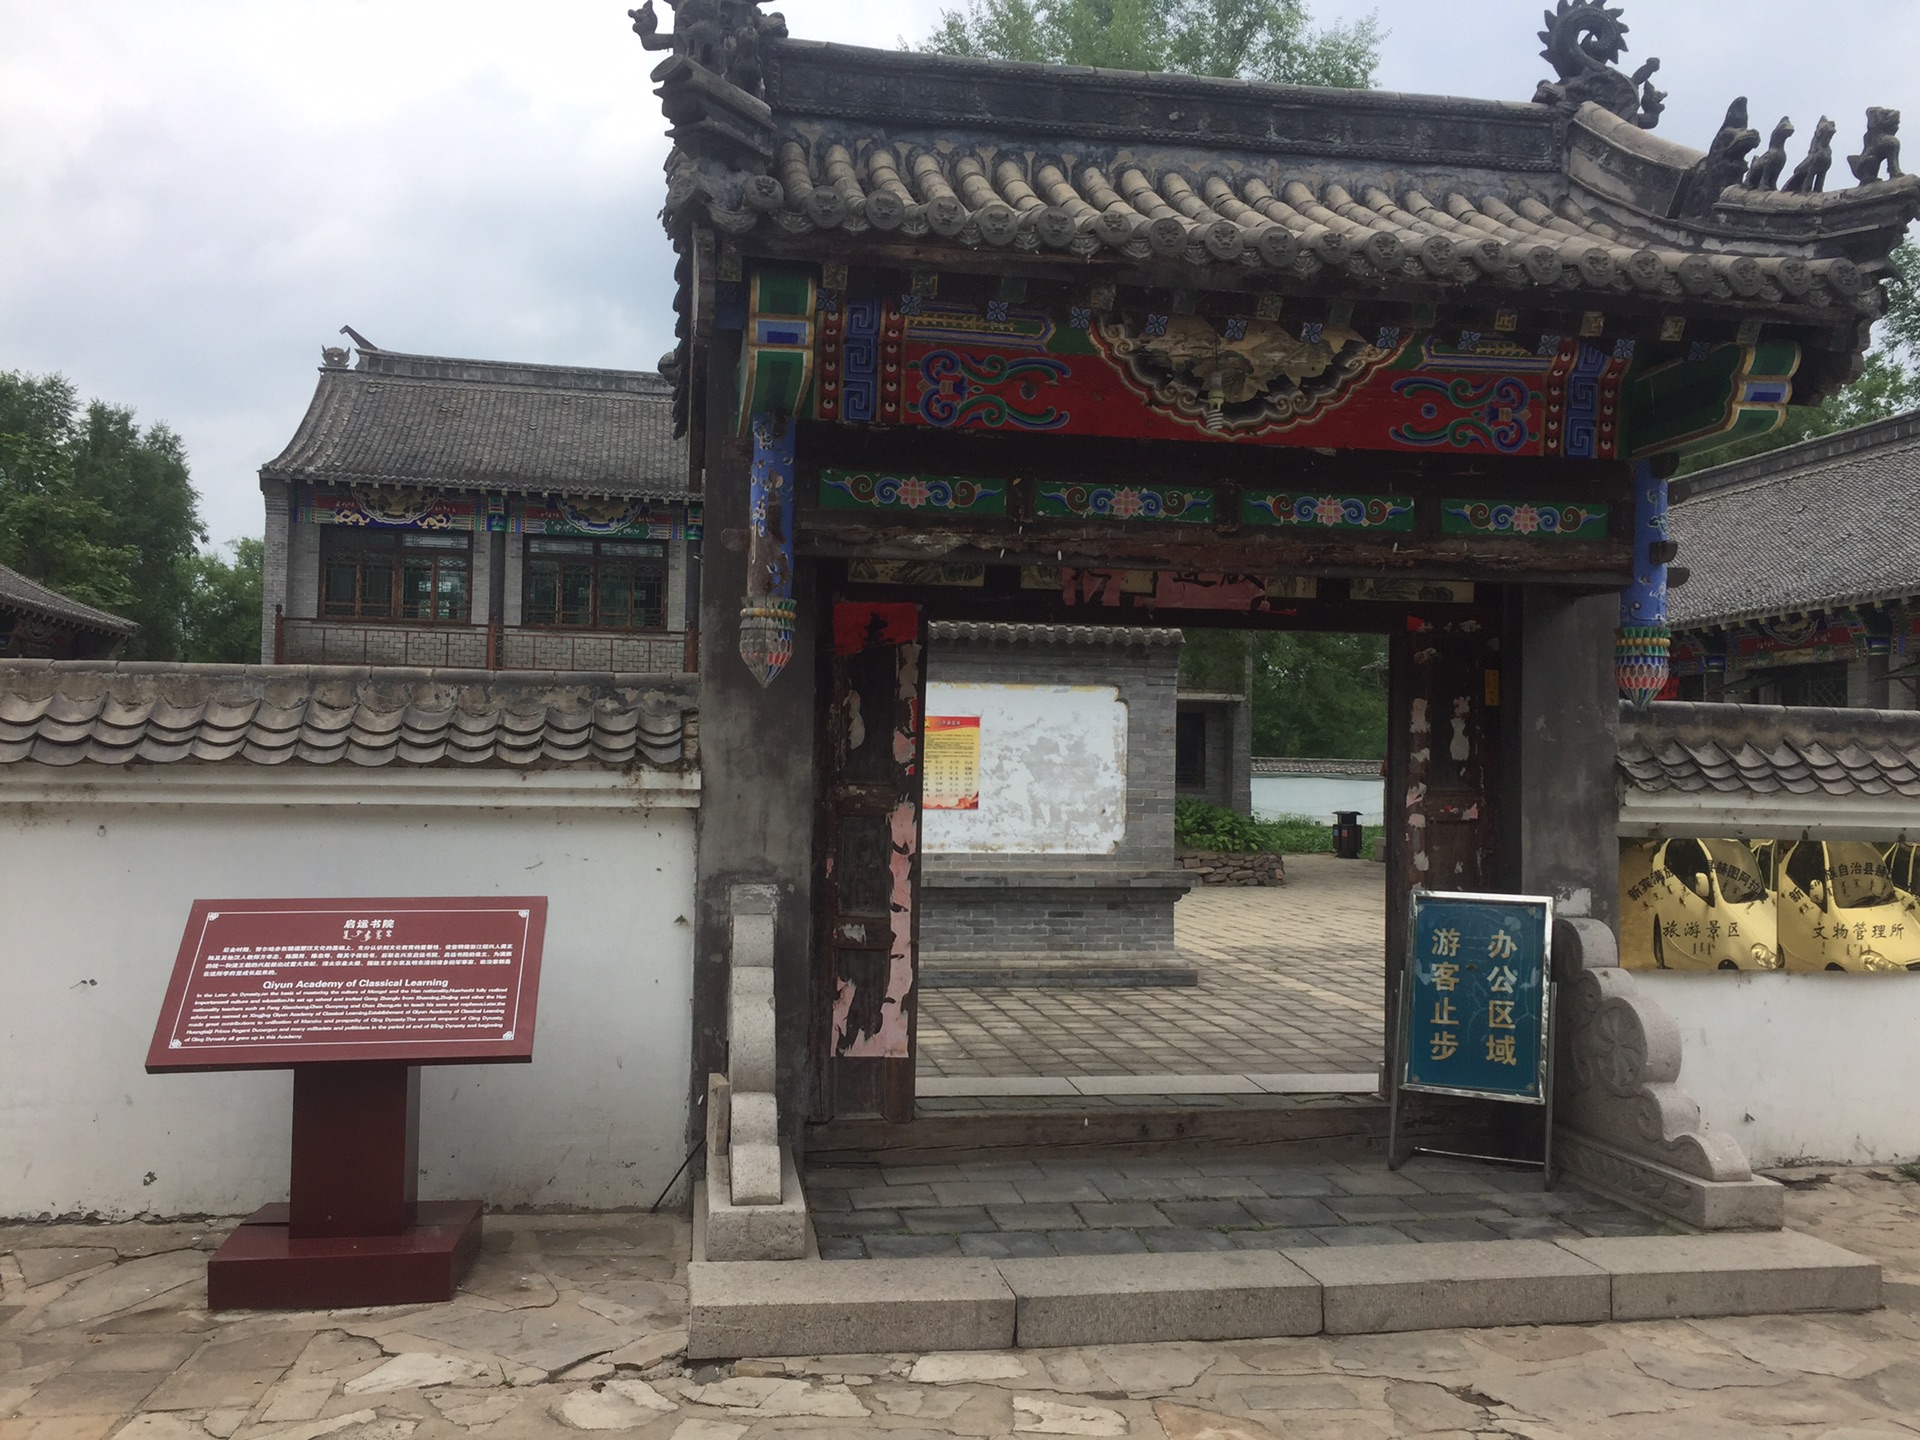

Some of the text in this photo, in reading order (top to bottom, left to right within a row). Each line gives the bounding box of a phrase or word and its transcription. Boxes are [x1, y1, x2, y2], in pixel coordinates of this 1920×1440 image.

[343, 919, 395, 929] 启运书院
[1663, 920, 1740, 941] 旅游景区
[1812, 921, 1905, 941] 文物管理所
[262, 978, 449, 990] Qiyun Academy of Classical Learning
[1430, 928, 1461, 1061] 游客止步
[1486, 929, 1517, 1066] 办公区域
